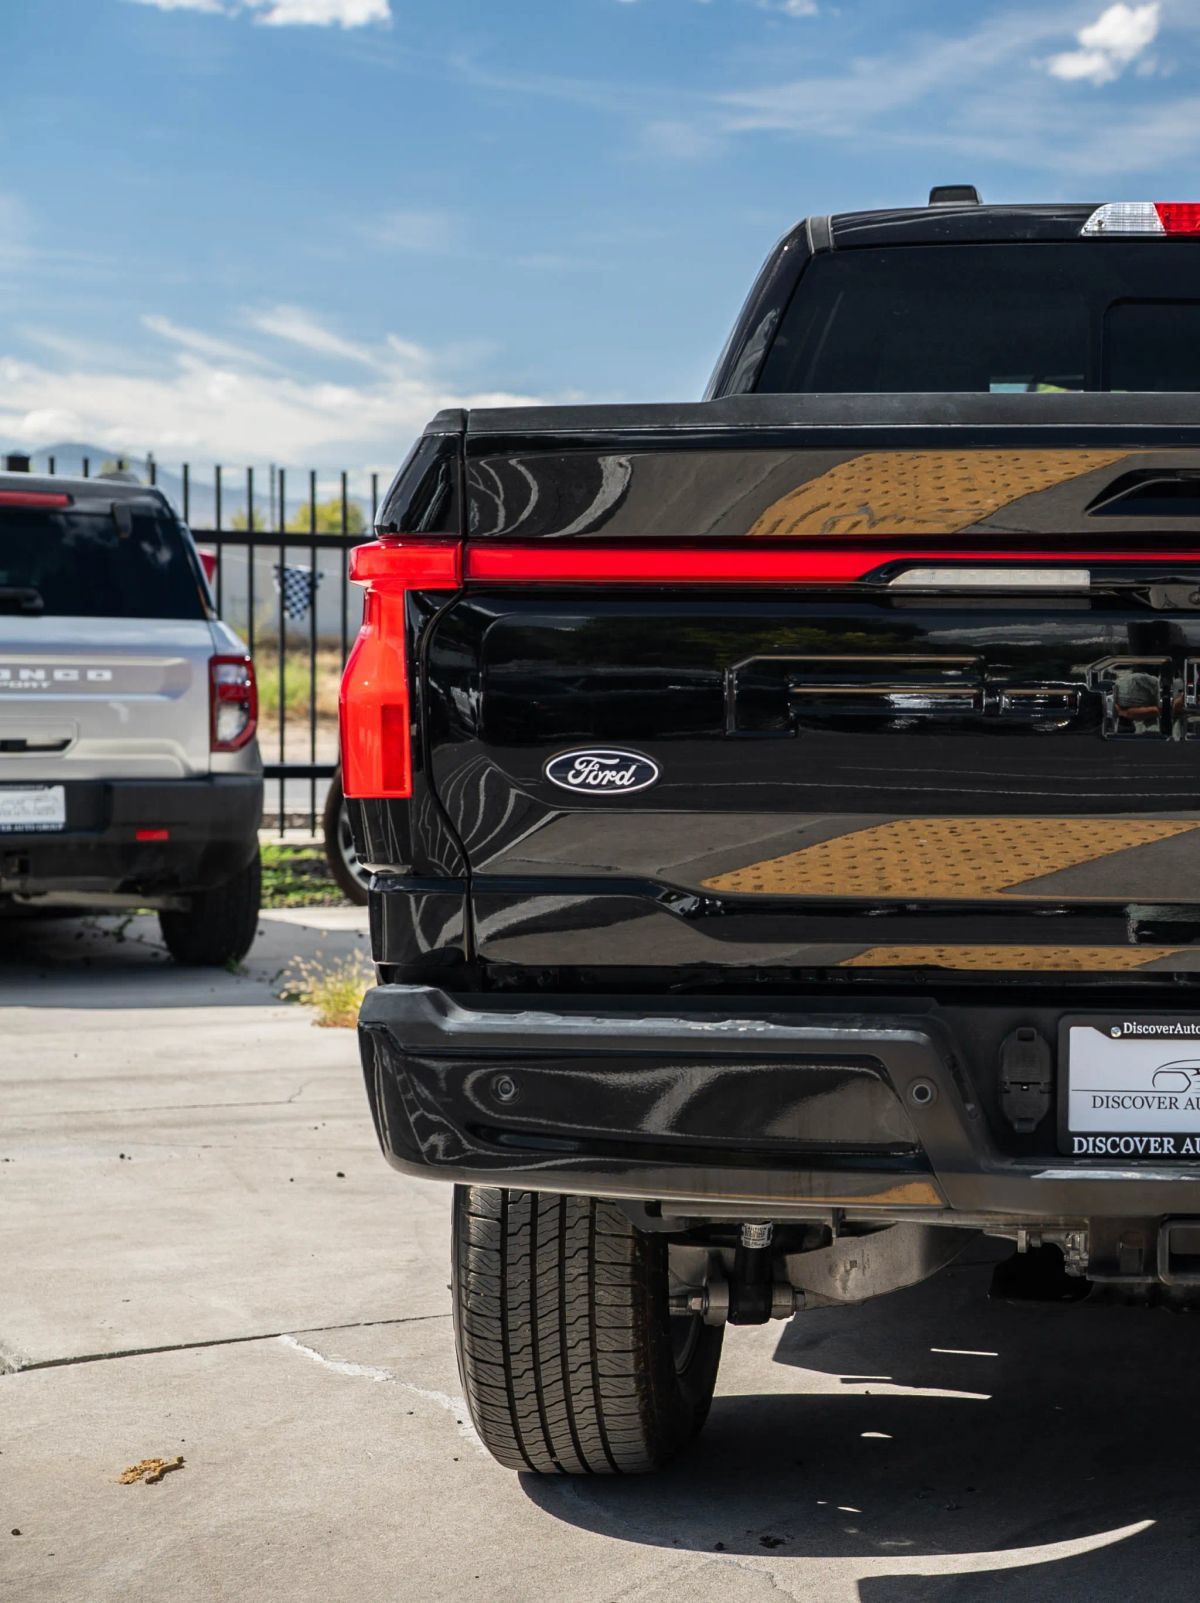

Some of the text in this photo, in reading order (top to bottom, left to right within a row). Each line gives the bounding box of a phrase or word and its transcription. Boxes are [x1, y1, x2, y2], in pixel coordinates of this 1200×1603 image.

[567, 756, 638, 786] Ford
[1092, 1095, 1180, 1110] DISCOVER
[1073, 1137, 1177, 1154] DISCOVER
